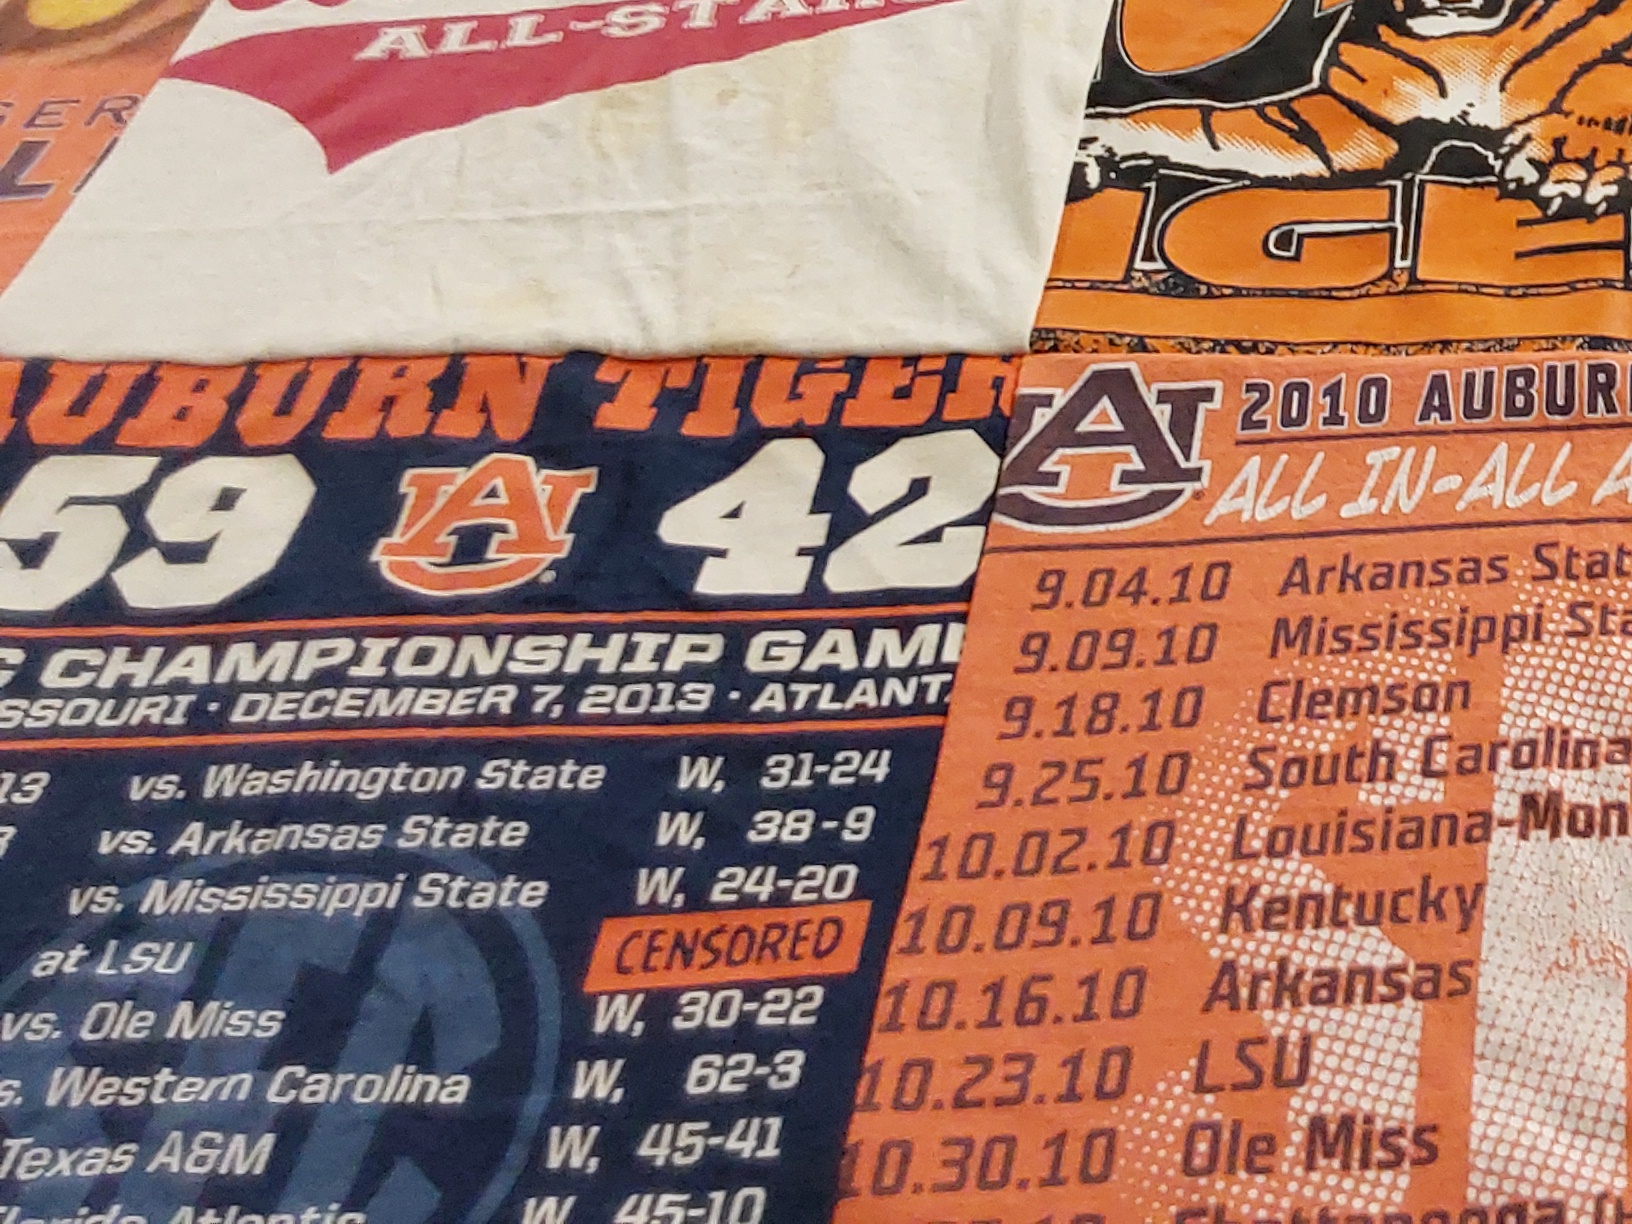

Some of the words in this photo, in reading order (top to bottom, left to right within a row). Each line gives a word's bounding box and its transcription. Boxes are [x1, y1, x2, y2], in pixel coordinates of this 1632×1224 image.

[1237, 373, 1391, 436] 2010
[658, 428, 1002, 595] 42
[1204, 451, 1327, 526] ALL
[1340, 441, 1579, 519] IN-ALL
[0, 454, 318, 611] 59
[1030, 560, 1233, 612] 9.04.10
[1277, 551, 1510, 598] Arkansas
[39, 631, 726, 690] CHAMPIONSHIP
[1013, 621, 1219, 676] 9.09.10
[1268, 603, 1546, 660] Mississippi
[228, 684, 519, 725] DECEMBER
[529, 684, 564, 720] 7,
[576, 680, 714, 714] 2013
[748, 672, 953, 714] ATLANT
[996, 684, 1206, 741] 9.18.10
[1257, 677, 1472, 725] Clemson
[128, 772, 187, 802] vs.
[201, 759, 465, 800] Washington
[475, 757, 607, 794] State
[676, 754, 726, 794] W,
[760, 749, 893, 790] 31-24
[975, 749, 1193, 811] 9.25.10
[1241, 737, 1398, 792] South
[97, 829, 157, 856] vs.
[166, 820, 387, 857] Arkansas
[396, 813, 530, 850] State
[654, 810, 706, 850] W,
[746, 805, 877, 844] 38-9
[920, 819, 1177, 883] 10.02.10
[67, 885, 125, 917] vs.
[139, 874, 405, 918] Mississippi
[412, 872, 550, 911] State
[634, 867, 687, 909] W,
[709, 863, 859, 903] 24-20
[896, 889, 1168, 956] 10.09.10
[1219, 875, 1487, 935] Kentucky
[31, 944, 90, 978] at
[95, 940, 195, 976] LSU
[614, 915, 845, 976] CENSORED
[0, 1009, 62, 1041] vs.
[79, 1001, 158, 1041] Ole
[166, 1001, 287, 1040] Miss
[592, 992, 647, 1038] W,
[671, 984, 825, 1030] 30-22
[877, 966, 1148, 1035] 10.16.10
[1201, 956, 1476, 1014] Arkansas
[45, 1066, 252, 1109] Western
[265, 1065, 472, 1106] Carolina
[571, 1058, 627, 1106] W,
[685, 1048, 807, 1096] 62-3
[855, 1044, 1134, 1114] 10.23.10
[1192, 1034, 1314, 1096] LSU
[0, 1136, 140, 1182] Texas
[146, 1131, 278, 1177] A&M
[545, 1124, 602, 1175] W,
[635, 1116, 783, 1167] 45-41
[840, 1126, 1119, 1200] 10.30.10
[1181, 1119, 1278, 1178] Ole
[1304, 1113, 1441, 1174] Miss
